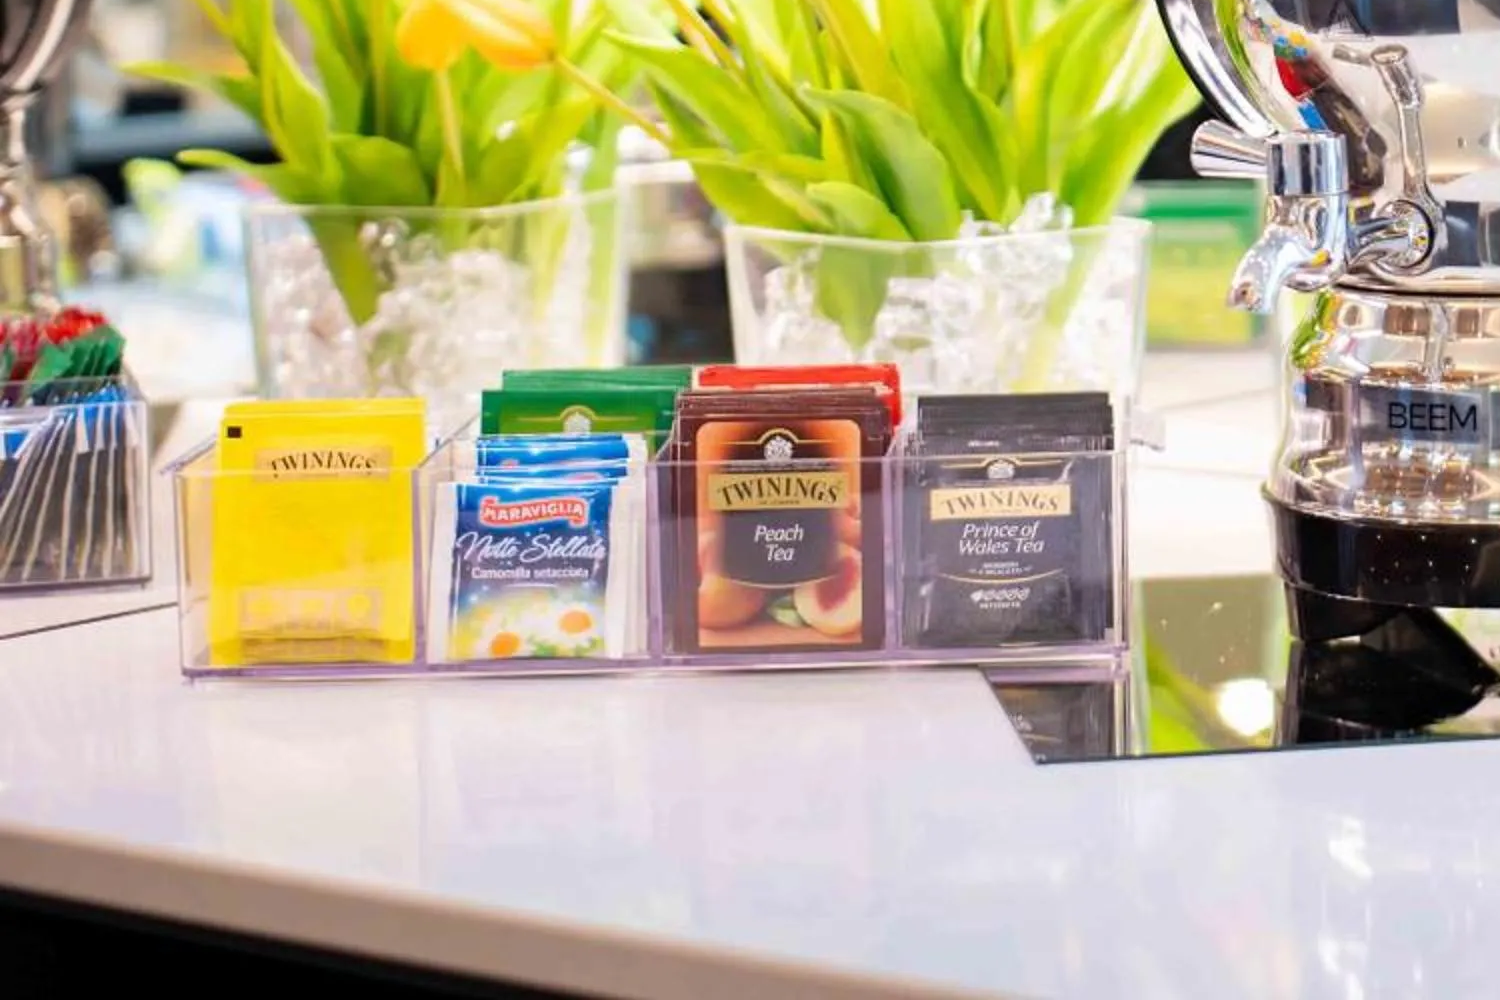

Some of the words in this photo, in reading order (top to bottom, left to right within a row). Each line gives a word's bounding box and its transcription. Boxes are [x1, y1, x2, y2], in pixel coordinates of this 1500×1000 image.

[1388, 402, 1477, 432] BEEM
[268, 450, 378, 477] TWININGS
[718, 476, 840, 506] TWININGS
[484, 502, 583, 521] MARAVIGLIA
[942, 490, 1060, 516] TWININGS
[754, 523, 804, 543] Peach
[963, 523, 1017, 539] Prince
[1021, 521, 1041, 539] of
[456, 531, 522, 562] Notte
[520, 533, 606, 563] Stellata
[765, 543, 796, 561] Tea
[959, 539, 1009, 555] Wales
[1014, 537, 1045, 553] Tea
[471, 566, 531, 579] Camomilla
